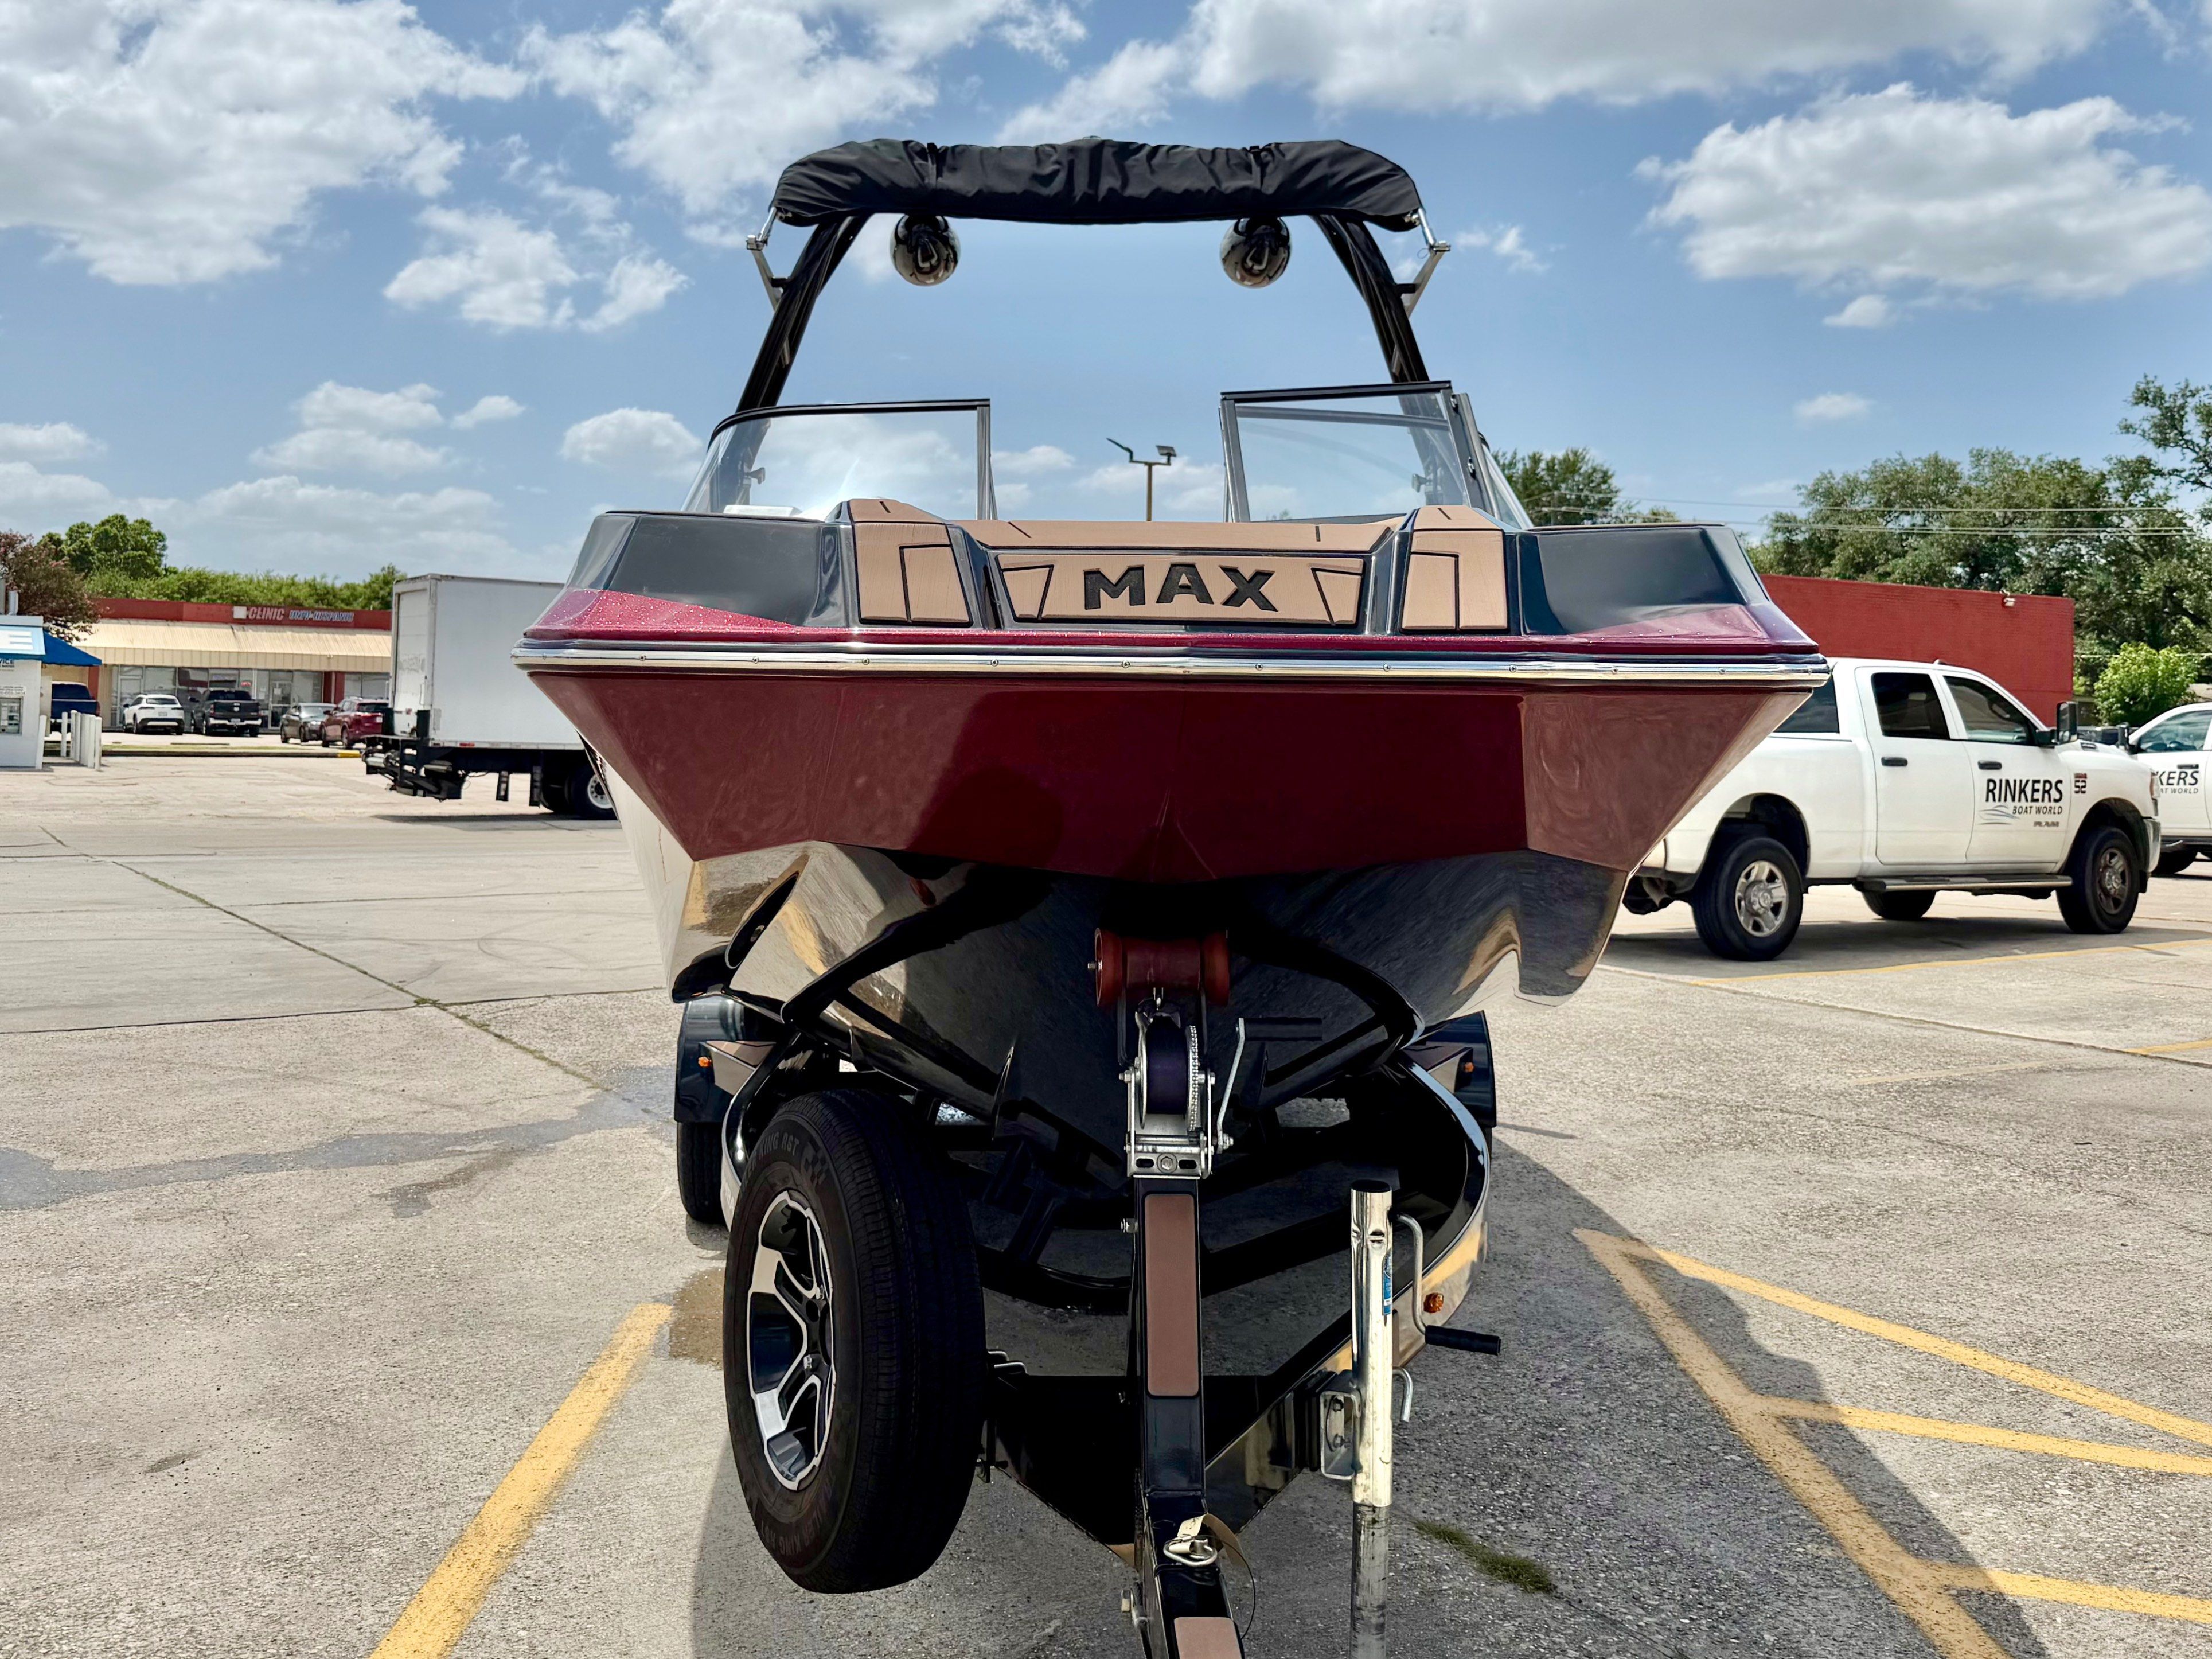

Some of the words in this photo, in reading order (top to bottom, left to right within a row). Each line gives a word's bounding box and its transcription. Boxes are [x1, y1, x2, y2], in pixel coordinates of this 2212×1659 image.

[1083, 563, 1278, 612] MAX
[248, 607, 285, 621] CLINIC
[1985, 778, 2063, 803] RINKERS
[2012, 805, 2033, 815] BOAT
[2035, 805, 2063, 815] WORLD
[782, 1132, 800, 1156] RST
